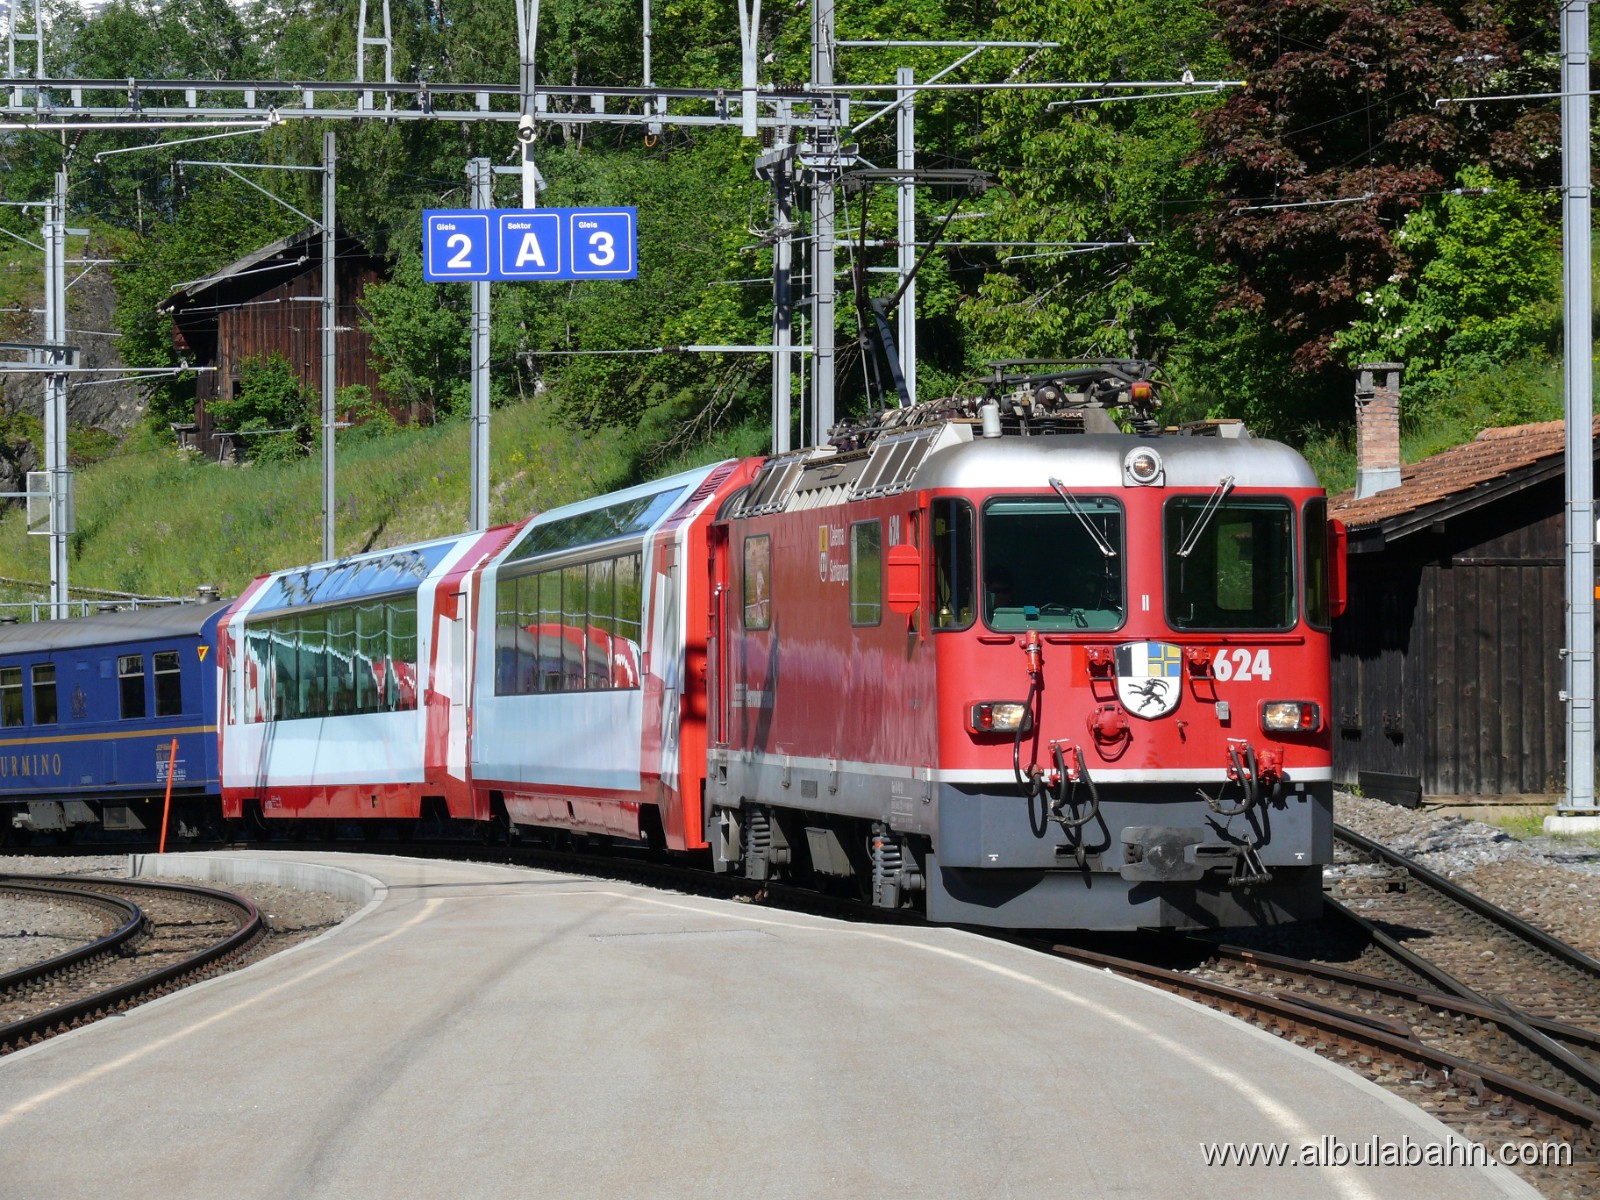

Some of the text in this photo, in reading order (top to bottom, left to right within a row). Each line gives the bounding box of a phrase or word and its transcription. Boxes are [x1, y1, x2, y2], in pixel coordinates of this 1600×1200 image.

[436, 223, 456, 231] Gleis
[507, 222, 531, 230] Sektor
[578, 221, 598, 229] Gleis
[446, 233, 472, 268] 2
[515, 232, 546, 267] A
[588, 231, 615, 266] 3
[889, 514, 900, 547] 624
[1212, 648, 1272, 682] 624
[0, 753, 61, 778] URMINO
